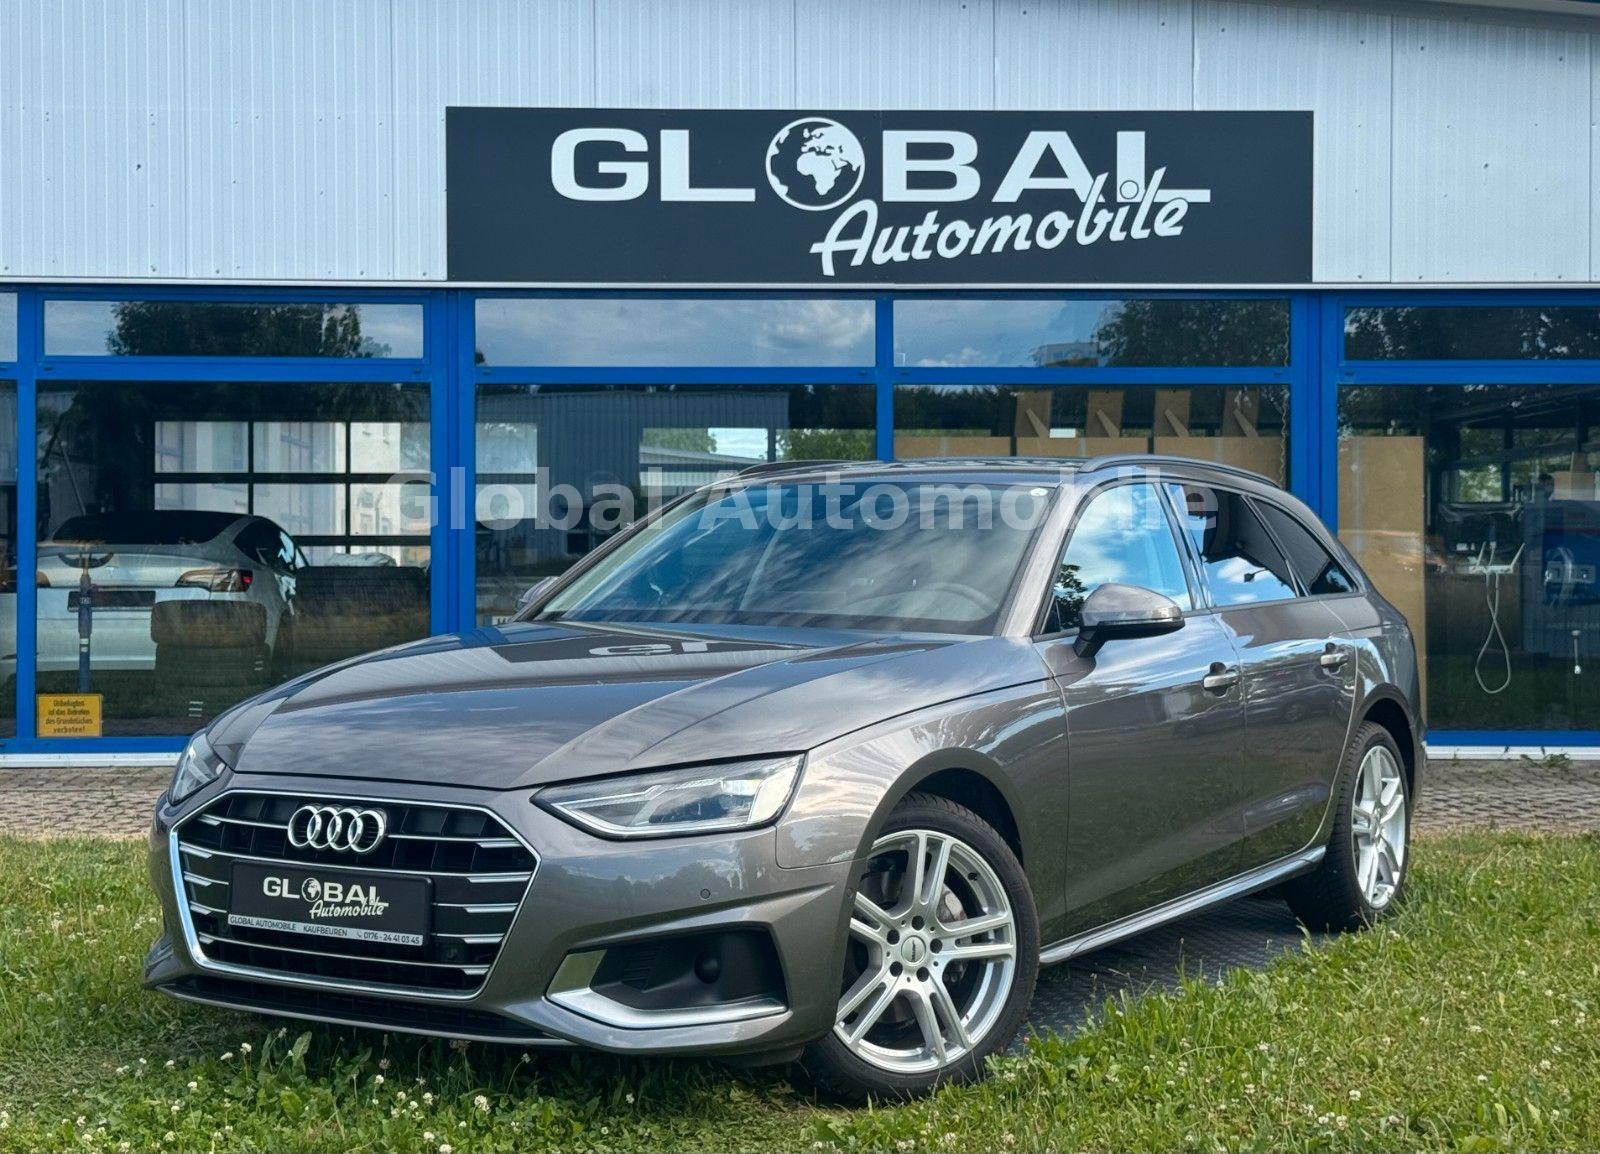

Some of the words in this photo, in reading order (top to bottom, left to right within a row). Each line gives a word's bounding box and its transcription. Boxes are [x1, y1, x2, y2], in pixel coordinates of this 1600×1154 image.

[551, 117, 1211, 212] GLOBAL
[809, 166, 1189, 276] Automobile
[263, 876, 389, 908] GLOBAL
[309, 896, 385, 919] Automobile
[230, 915, 254, 926] GLOBAL
[255, 918, 297, 931] AUTOMOBILE
[303, 924, 348, 937] KAUFBEUREN
[363, 931, 379, 940] 0176
[384, 933, 393, 942] 24
[401, 936, 410, 944] 03
[410, 937, 420, 945] 45
